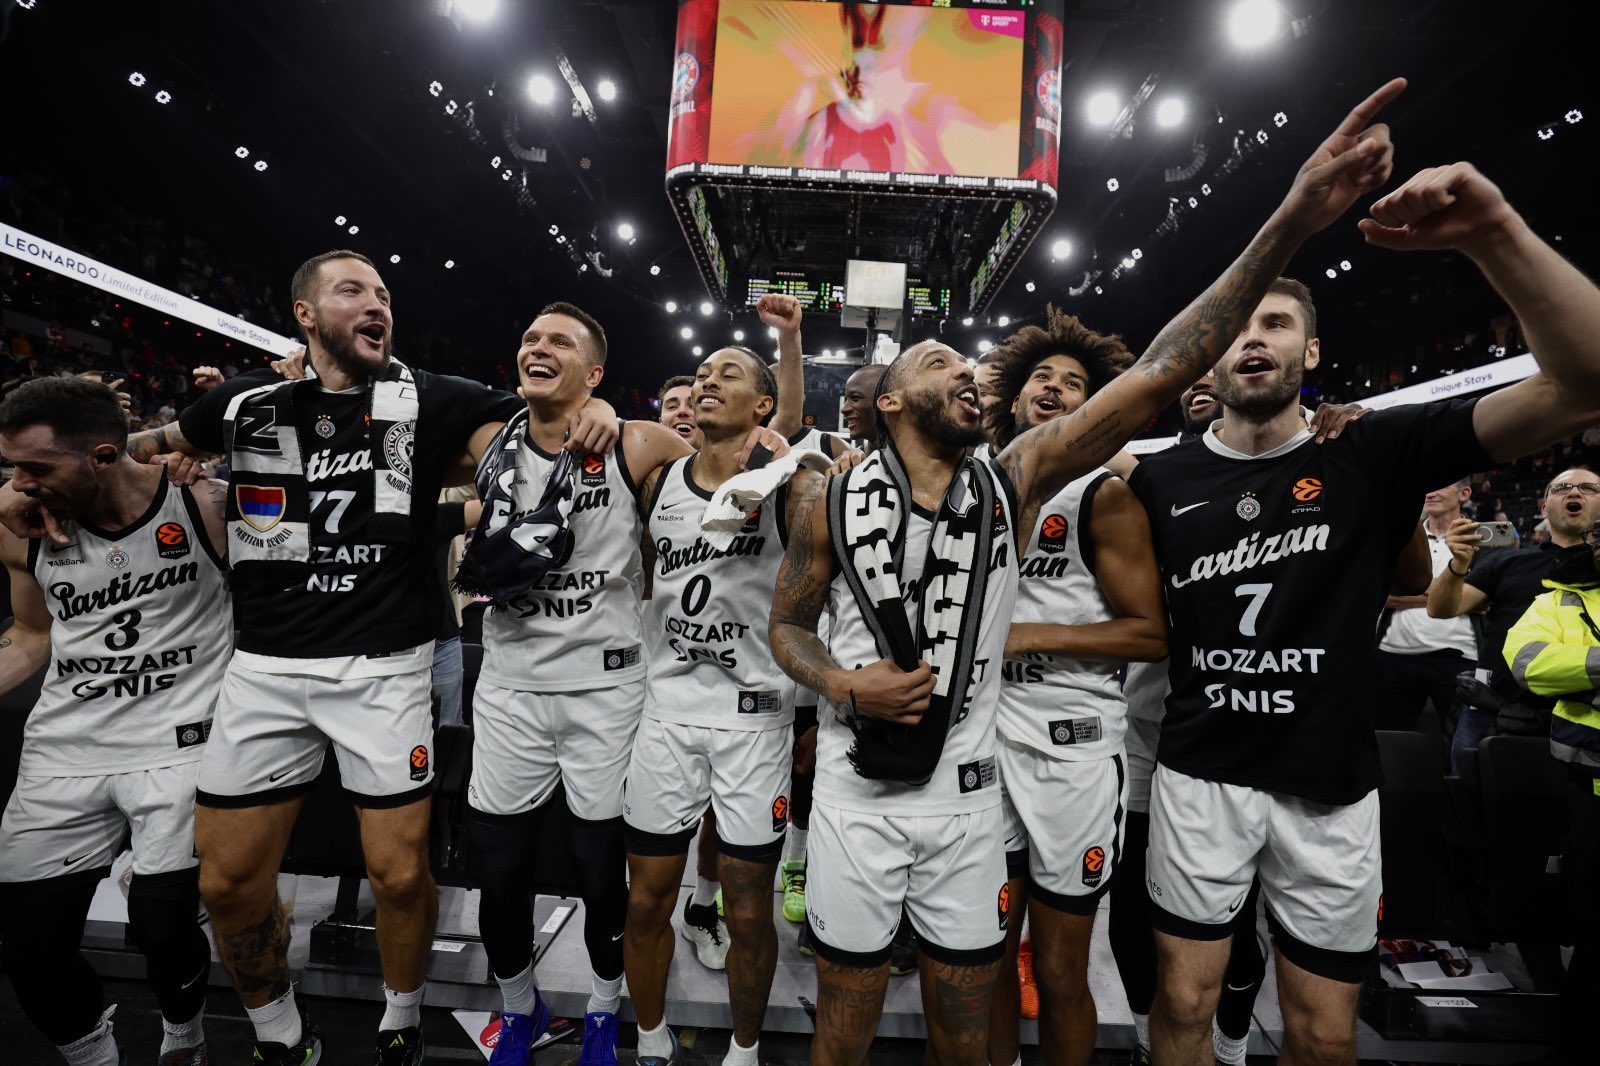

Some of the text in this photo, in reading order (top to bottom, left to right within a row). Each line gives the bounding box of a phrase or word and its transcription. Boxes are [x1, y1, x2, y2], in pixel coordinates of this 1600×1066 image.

[5, 234, 178, 310] LEONARDO Limited Edition
[217, 317, 270, 345] Unique Stays
[1431, 372, 1493, 396] Unique Stays
[1291, 505, 1321, 514] ETIHAD
[235, 526, 264, 548] PARTIZAN
[53, 556, 86, 567] AikBank
[311, 544, 387, 564] ZART
[50, 561, 198, 622] Partizan
[306, 573, 357, 592] NIS
[531, 570, 610, 590] ZZART
[545, 595, 593, 618] NIS
[681, 574, 711, 617] 0
[1234, 582, 1273, 637] 7
[104, 609, 142, 651] 3
[57, 645, 197, 677] MOZZART
[1192, 645, 1326, 674] MOZZART
[114, 674, 177, 698] NIS
[1231, 687, 1296, 714] NIS
